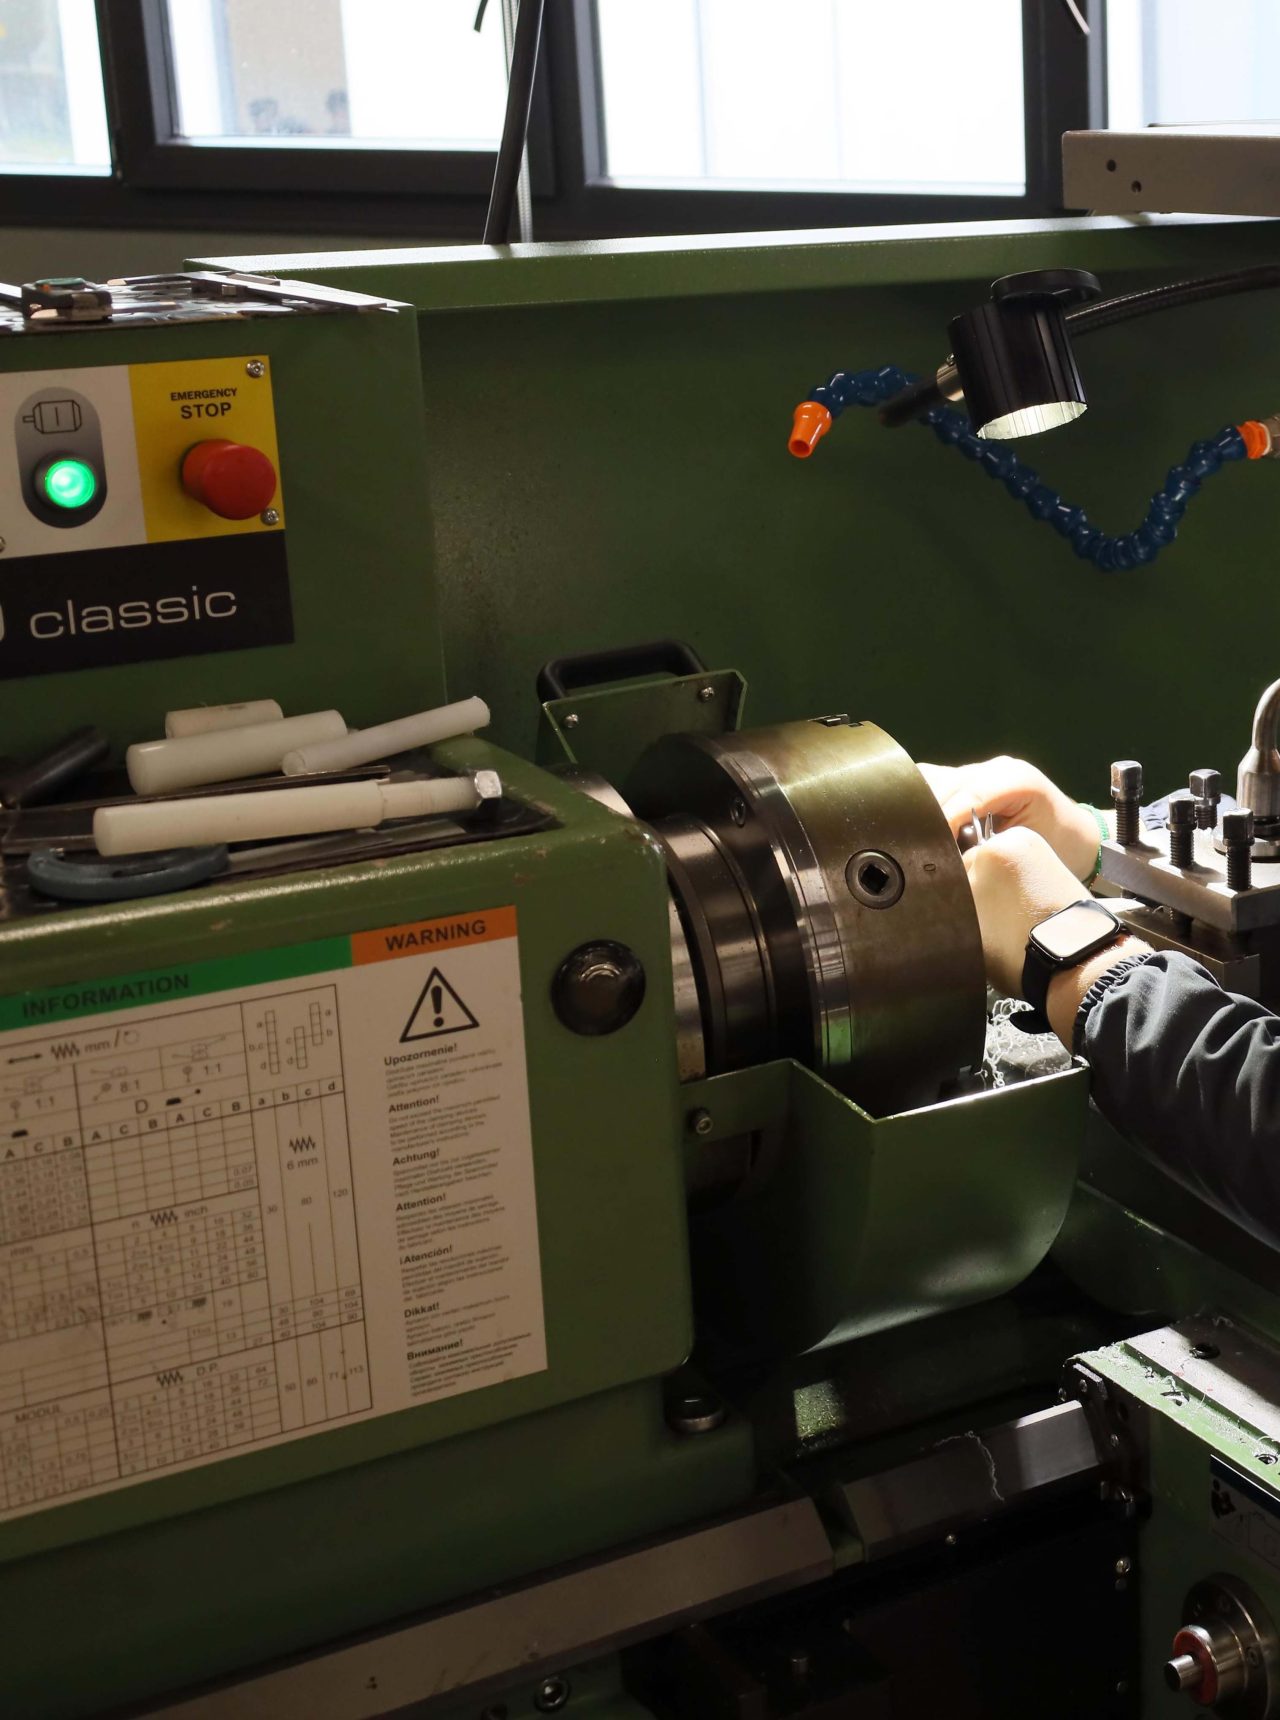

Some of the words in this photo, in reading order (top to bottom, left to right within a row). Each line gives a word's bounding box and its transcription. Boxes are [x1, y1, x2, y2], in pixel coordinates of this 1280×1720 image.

[170, 387, 238, 402] EMERGENCY
[180, 401, 232, 420] STOP
[30, 585, 237, 639] classic
[385, 919, 487, 951] WARNING
[22, 973, 190, 1019] INFORMATION
[384, 1043, 458, 1067] Upozornenie!
[389, 1095, 440, 1113] Attention!
[392, 1147, 440, 1167] Achtung!
[396, 1192, 447, 1212] Attention!
[400, 1244, 453, 1266] ¡Atención!
[404, 1301, 440, 1319] Dikkat!
[407, 1338, 464, 1362] Внимание!
